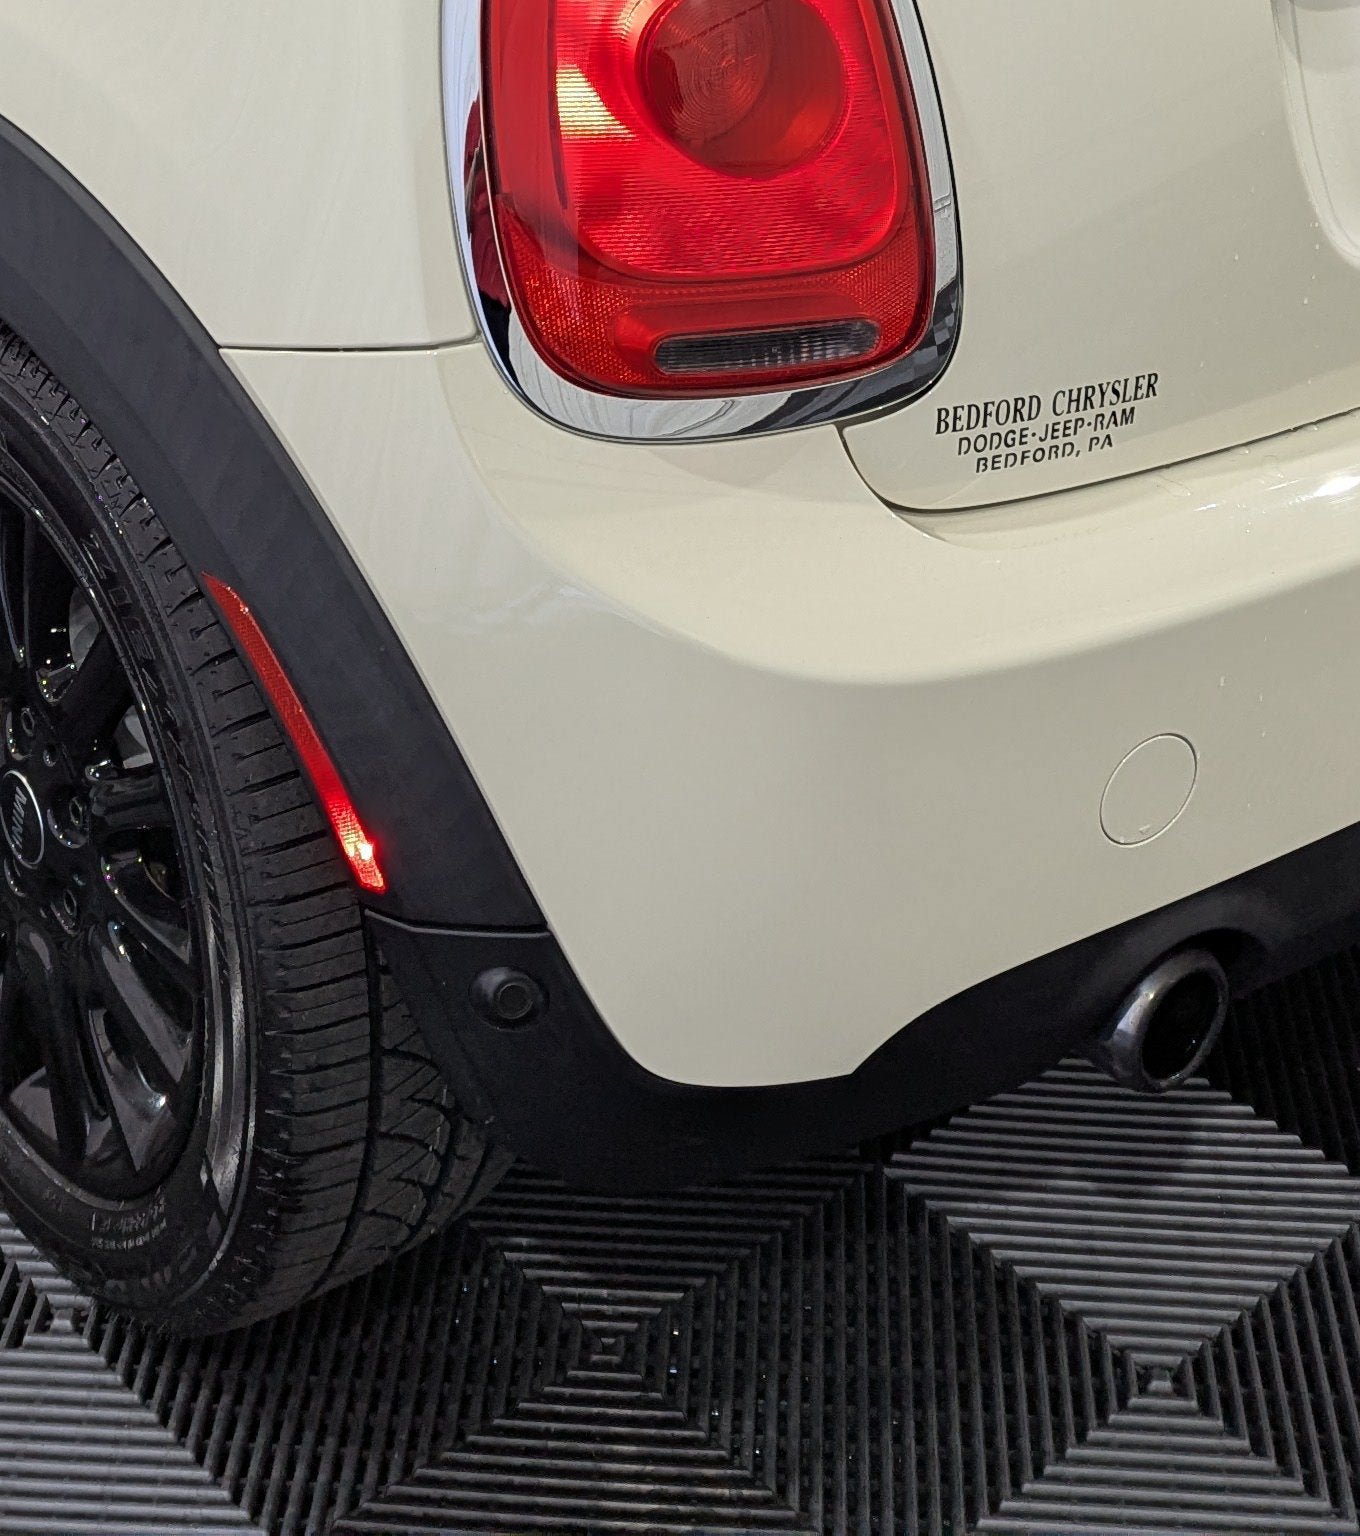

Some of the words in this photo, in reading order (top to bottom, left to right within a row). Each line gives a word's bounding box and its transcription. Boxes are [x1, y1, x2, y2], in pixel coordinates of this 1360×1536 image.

[935, 394, 1041, 435] BEDFORD
[1052, 372, 1159, 416] CHRYSLER
[975, 440, 1081, 474] BEDFORD,
[1088, 433, 1113, 453] PA
[11, 786, 28, 850] MINI
